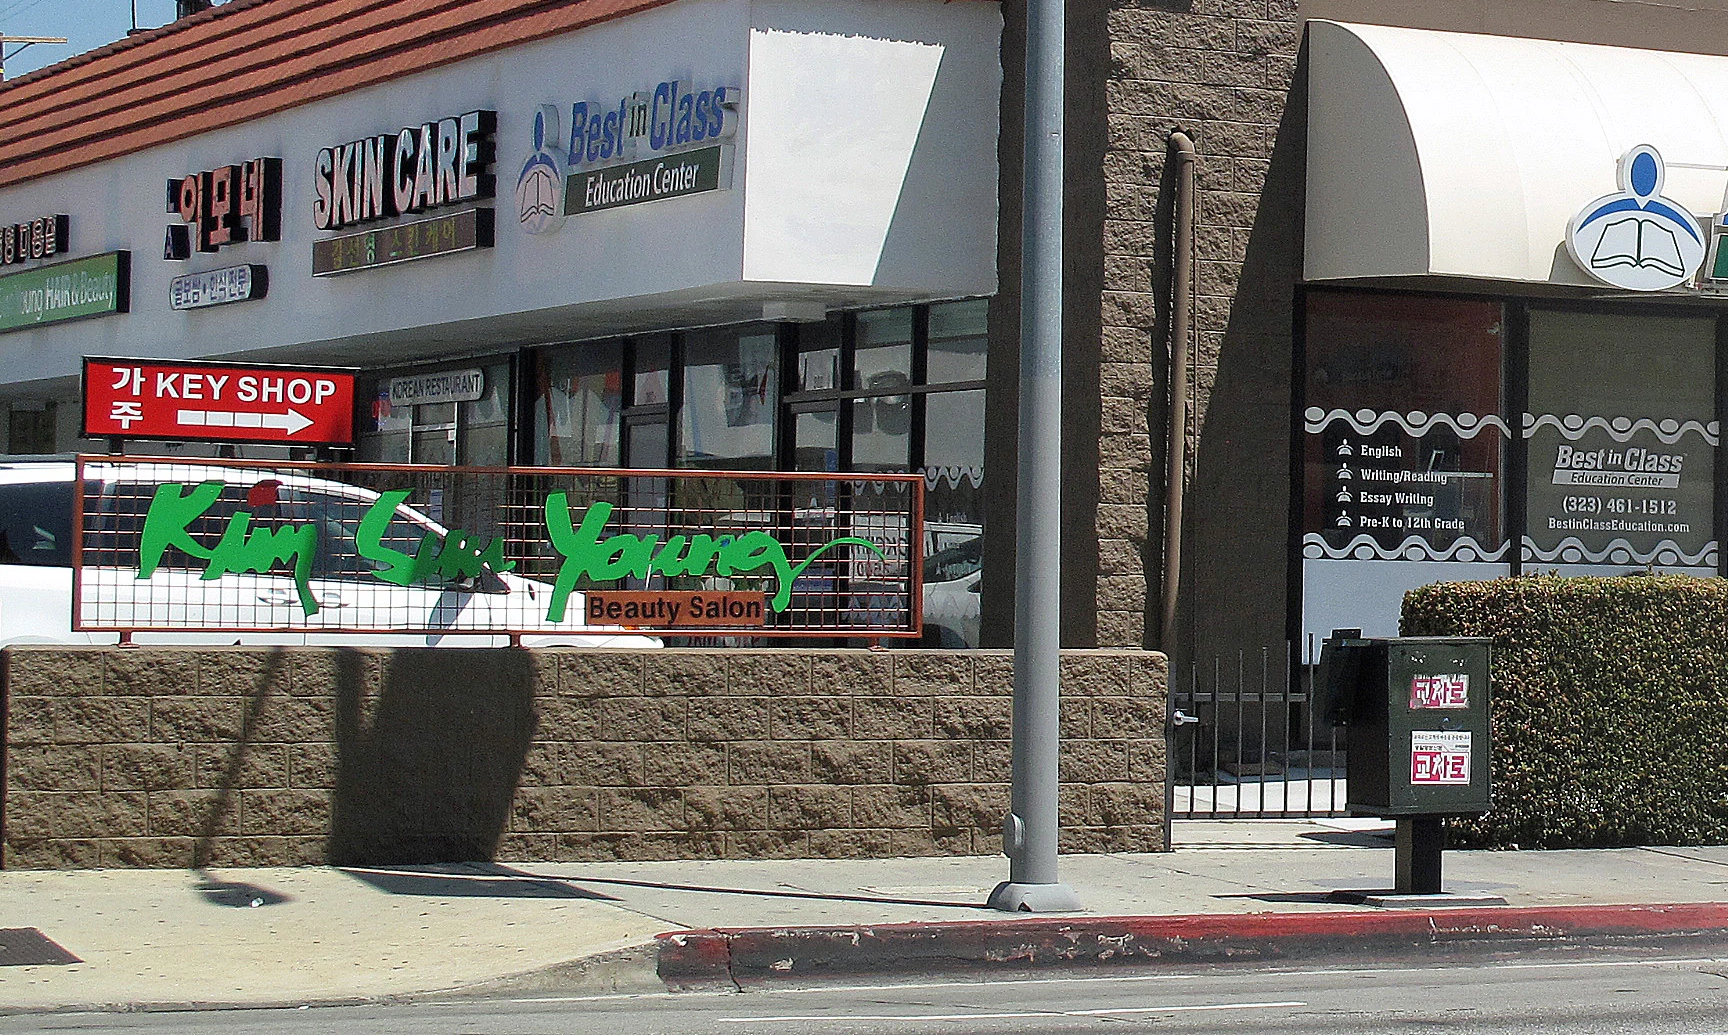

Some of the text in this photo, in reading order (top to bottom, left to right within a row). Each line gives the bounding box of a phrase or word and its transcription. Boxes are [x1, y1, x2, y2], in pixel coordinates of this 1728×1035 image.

[568, 81, 726, 165] Best in Class
[314, 112, 479, 230] SKIN CARE
[585, 161, 699, 207] Education Center
[180, 158, 265, 253] 이모네
[156, 371, 231, 401] KEY
[237, 376, 337, 405] SHOP
[392, 373, 480, 400] KOREAN RESTAURANT
[1360, 445, 1402, 458] English
[1555, 445, 1684, 472] Best in Class
[1360, 469, 1448, 485] Writing/Reading
[1571, 472, 1664, 486] Education Center
[1360, 492, 1434, 507] Essay Writing
[1562, 495, 1677, 515] (323) 461-1512
[1359, 515, 1465, 529] Pre-K to 12th Grade
[1548, 517, 1690, 532] BestinClassEducation.com
[135, 479, 319, 617] Kim
[545, 488, 887, 622] Young
[590, 595, 761, 625] Beauty Salon
